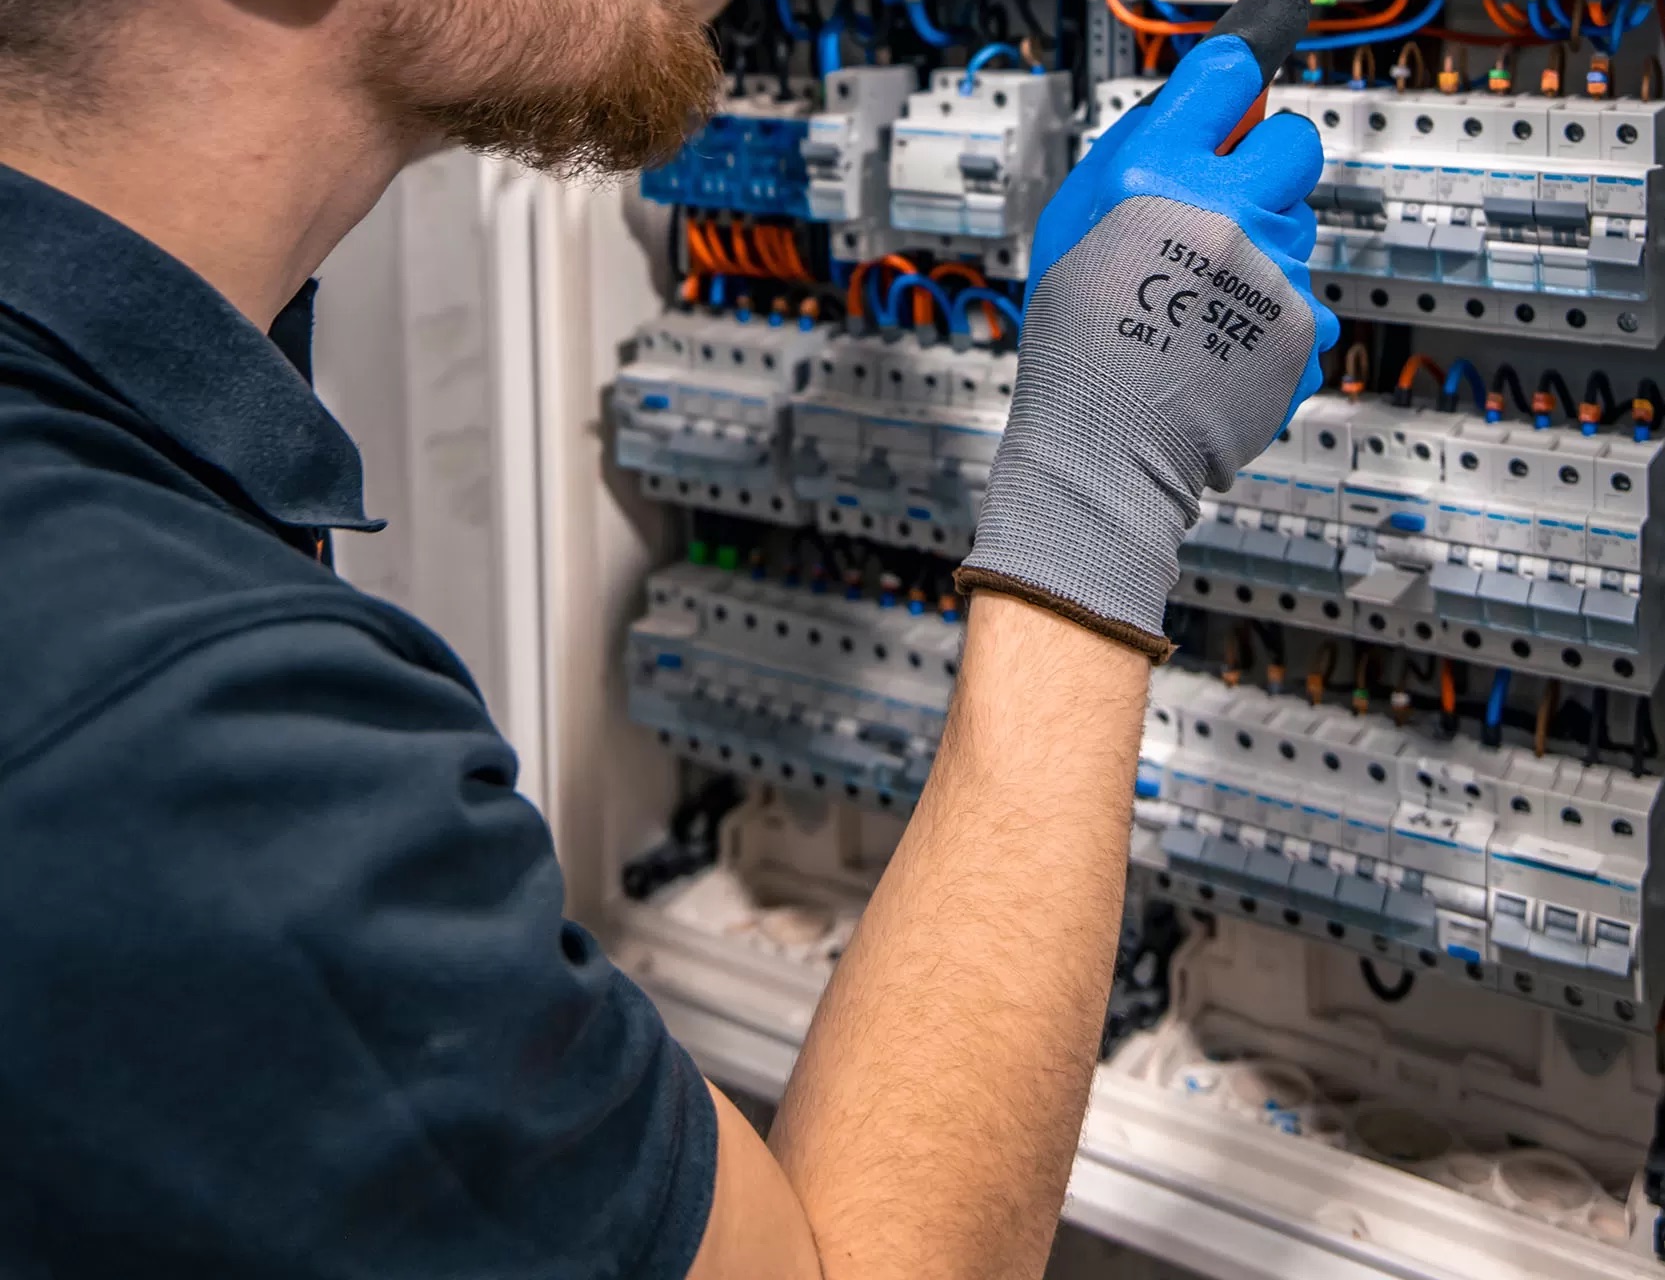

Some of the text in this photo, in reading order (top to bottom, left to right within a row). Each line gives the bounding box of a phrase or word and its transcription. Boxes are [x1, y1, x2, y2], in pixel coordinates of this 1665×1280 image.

[1138, 273, 1265, 352] CE SIZE
[1160, 238, 1282, 321] 1512-600009
[1203, 332, 1234, 362] 9/L
